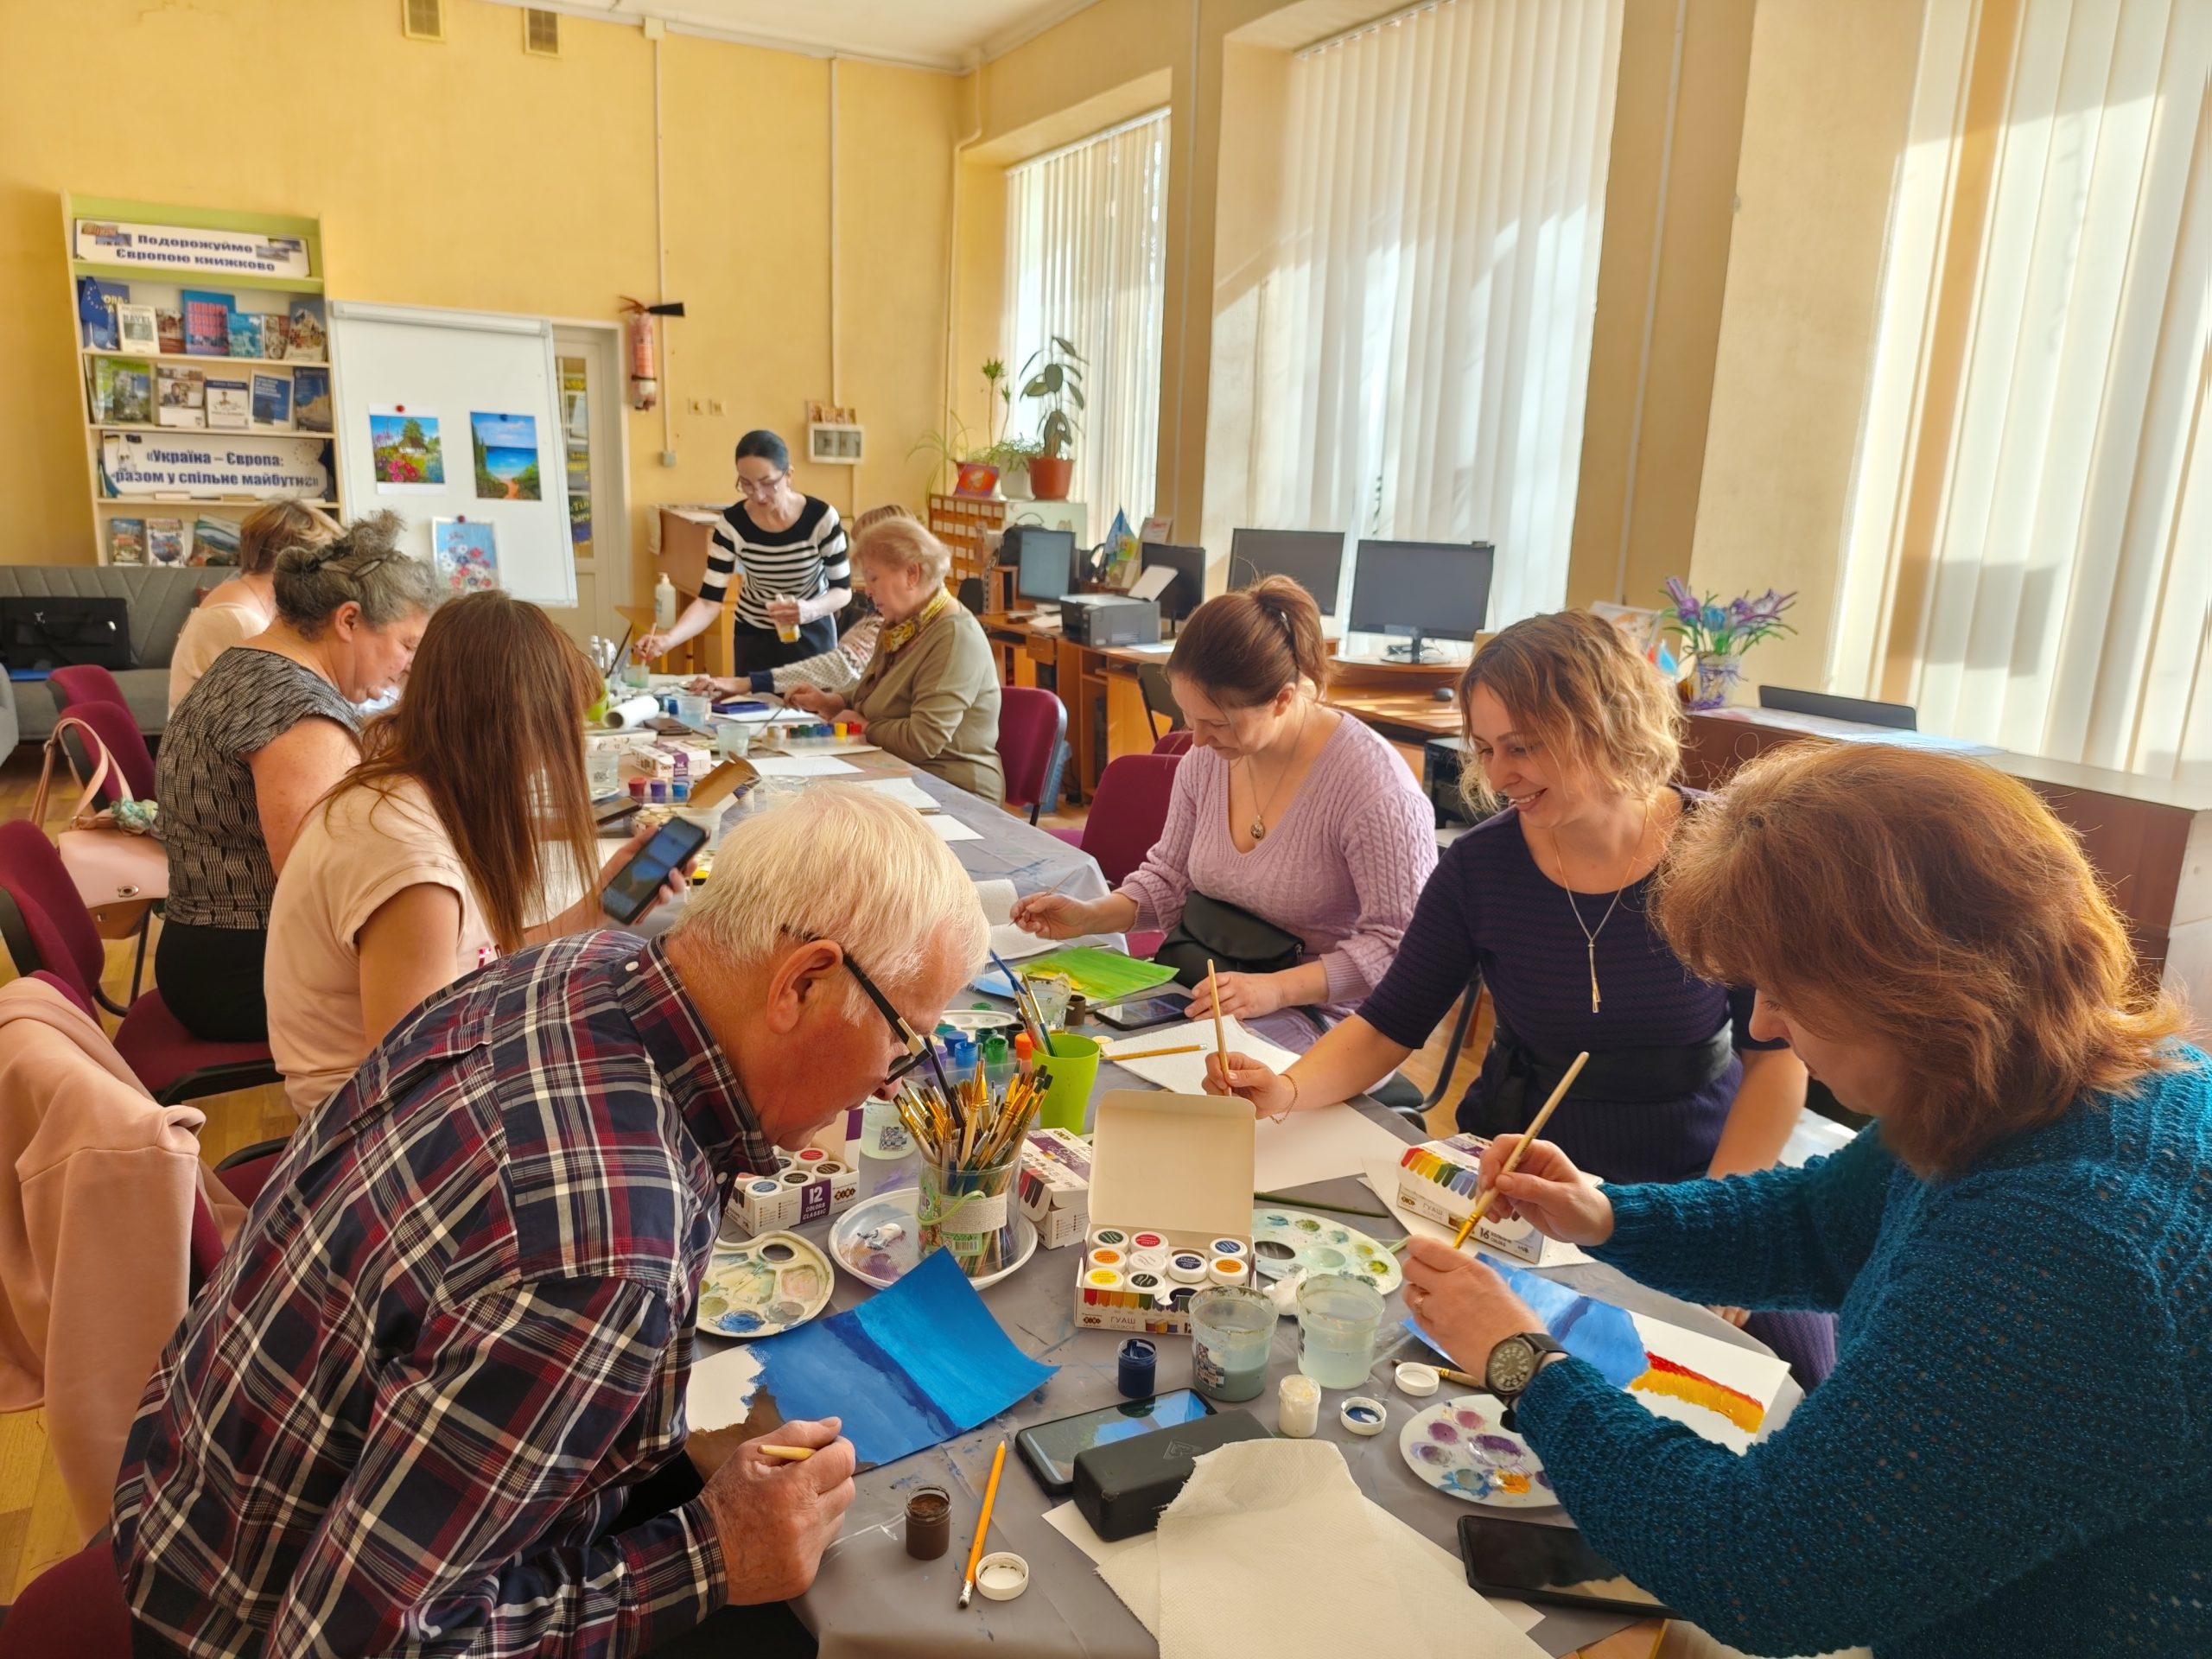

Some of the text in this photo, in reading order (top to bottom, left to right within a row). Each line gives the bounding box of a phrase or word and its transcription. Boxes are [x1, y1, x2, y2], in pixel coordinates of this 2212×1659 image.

[137, 233, 253, 254] Подорожуймо
[116, 247, 276, 272] Європою книжково
[147, 448, 212, 465] «Україна
[226, 452, 284, 467] Європа:
[116, 471, 164, 484] разом
[167, 473, 176, 486] у
[179, 470, 238, 486] спільне
[809, 1186, 823, 1205] 12
[802, 1209, 827, 1220] CLASSIC
[805, 1202, 826, 1212] COLORS
[1479, 1227, 1491, 1240] 16
[1110, 1316, 1136, 1325] ГУАШ
